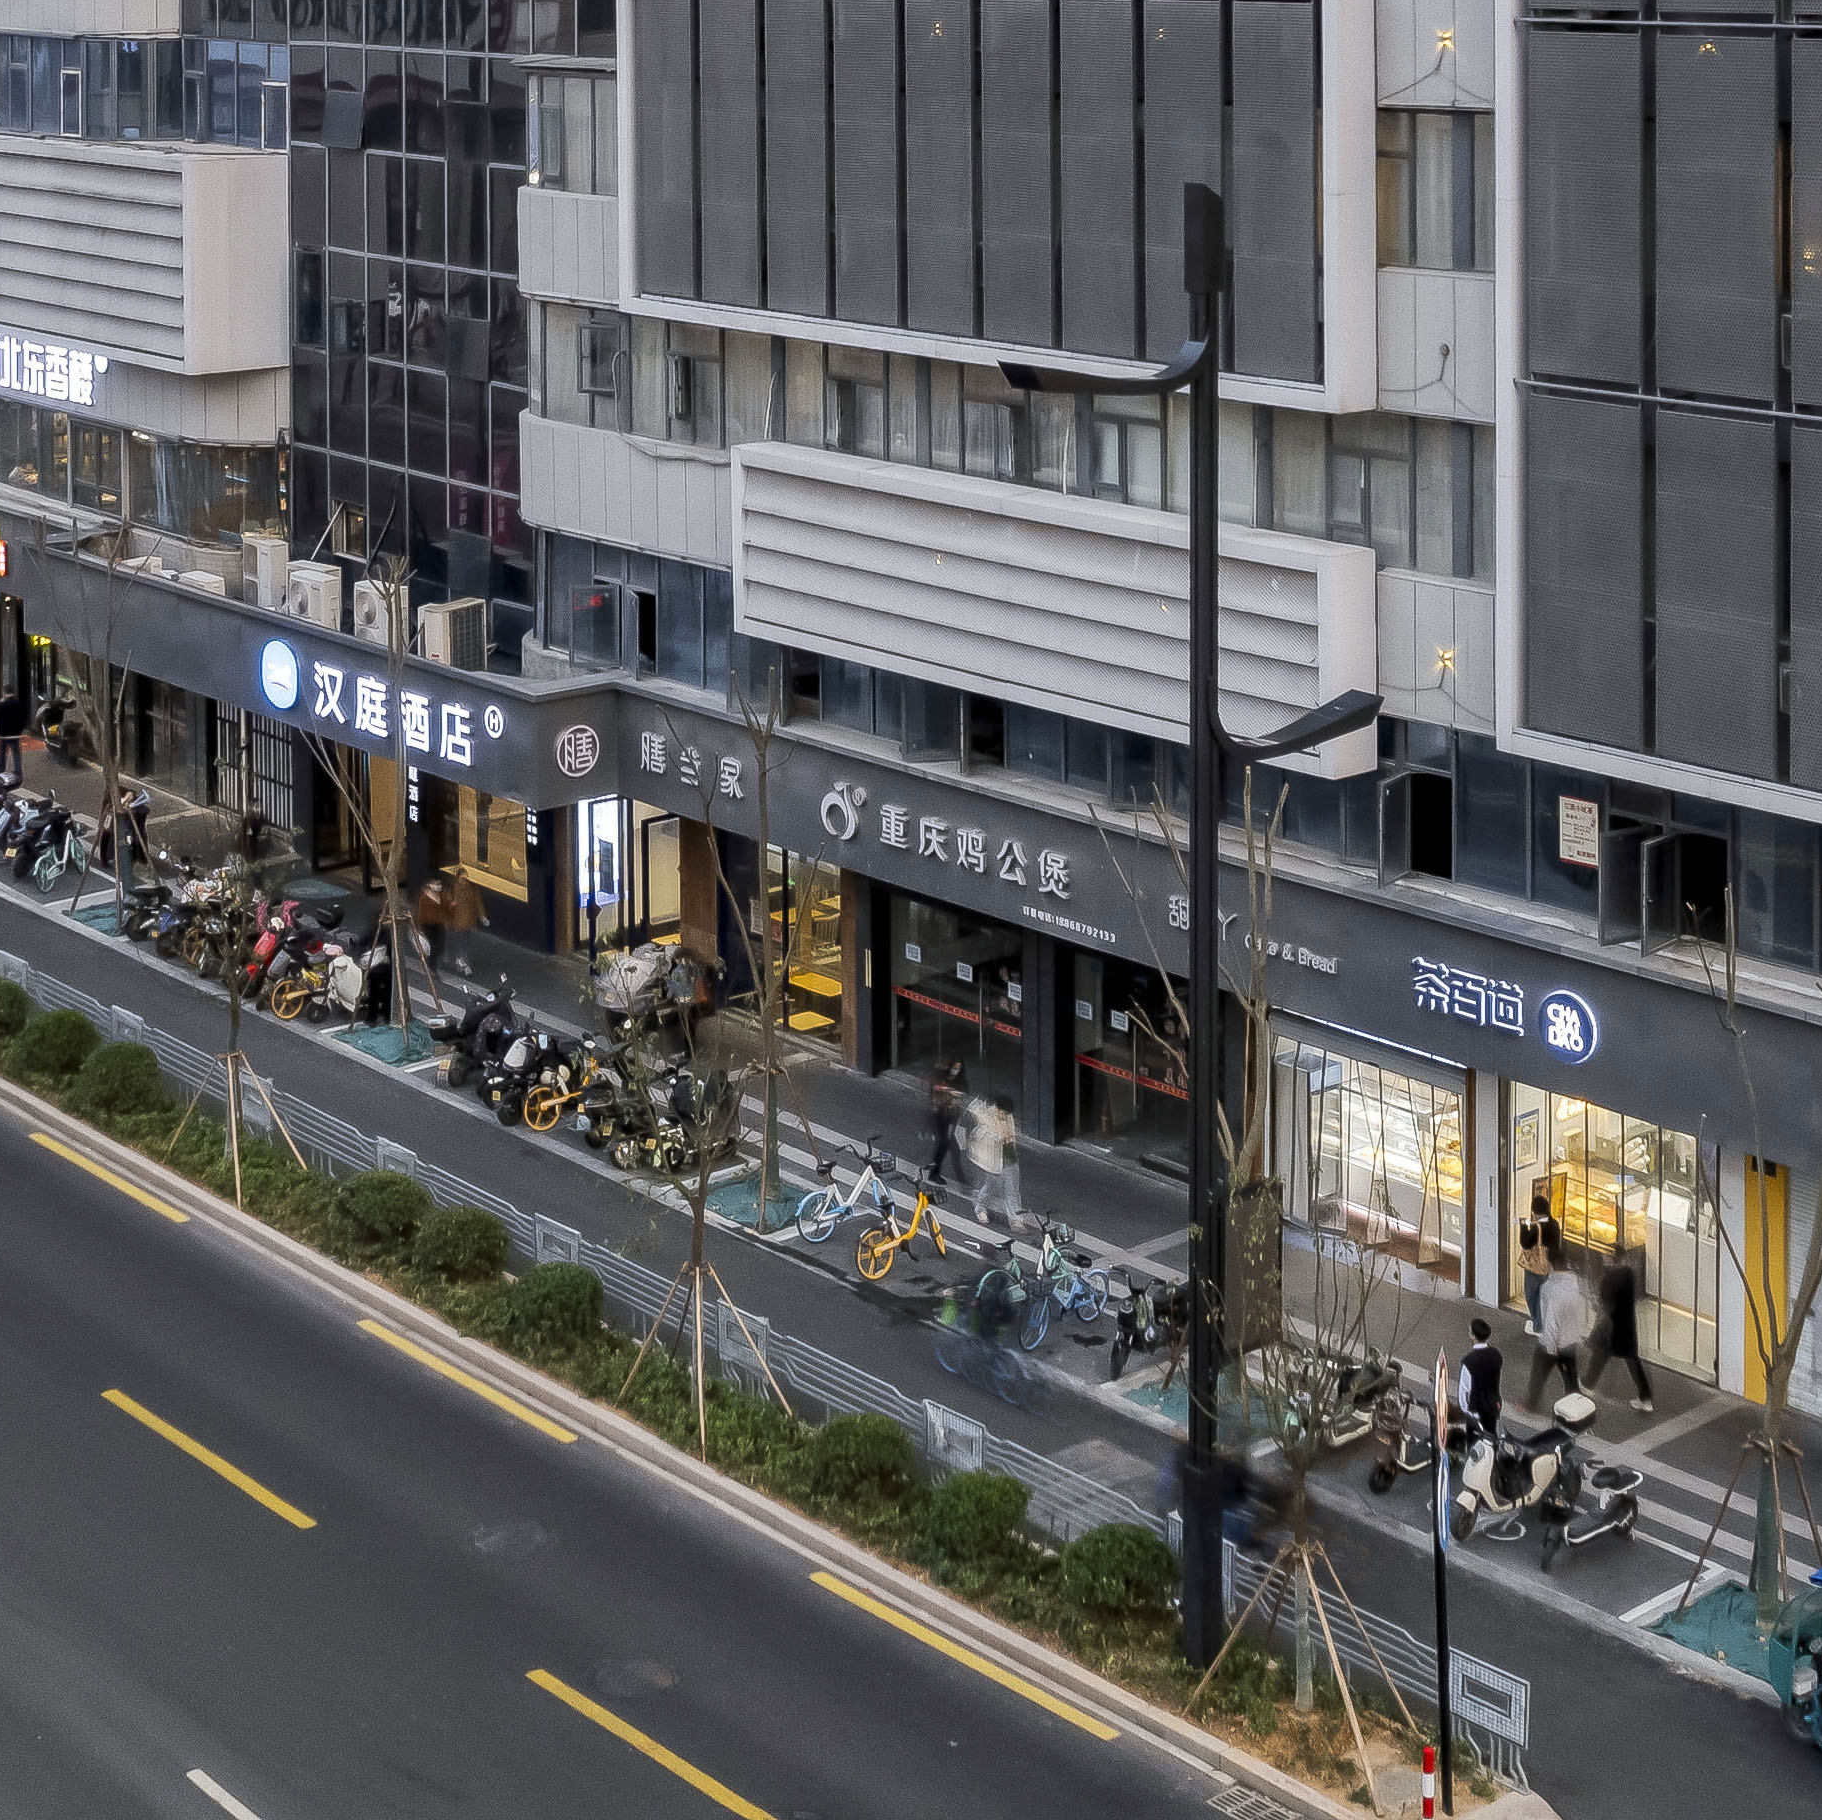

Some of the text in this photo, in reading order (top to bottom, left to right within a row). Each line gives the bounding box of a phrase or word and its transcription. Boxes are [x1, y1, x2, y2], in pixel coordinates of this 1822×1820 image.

[313, 660, 473, 767] 汉庭酒店
[879, 803, 1072, 900] 重庆鸡公煲
[1297, 946, 1338, 975] Bread
[1411, 956, 1525, 1037] 茶百道
